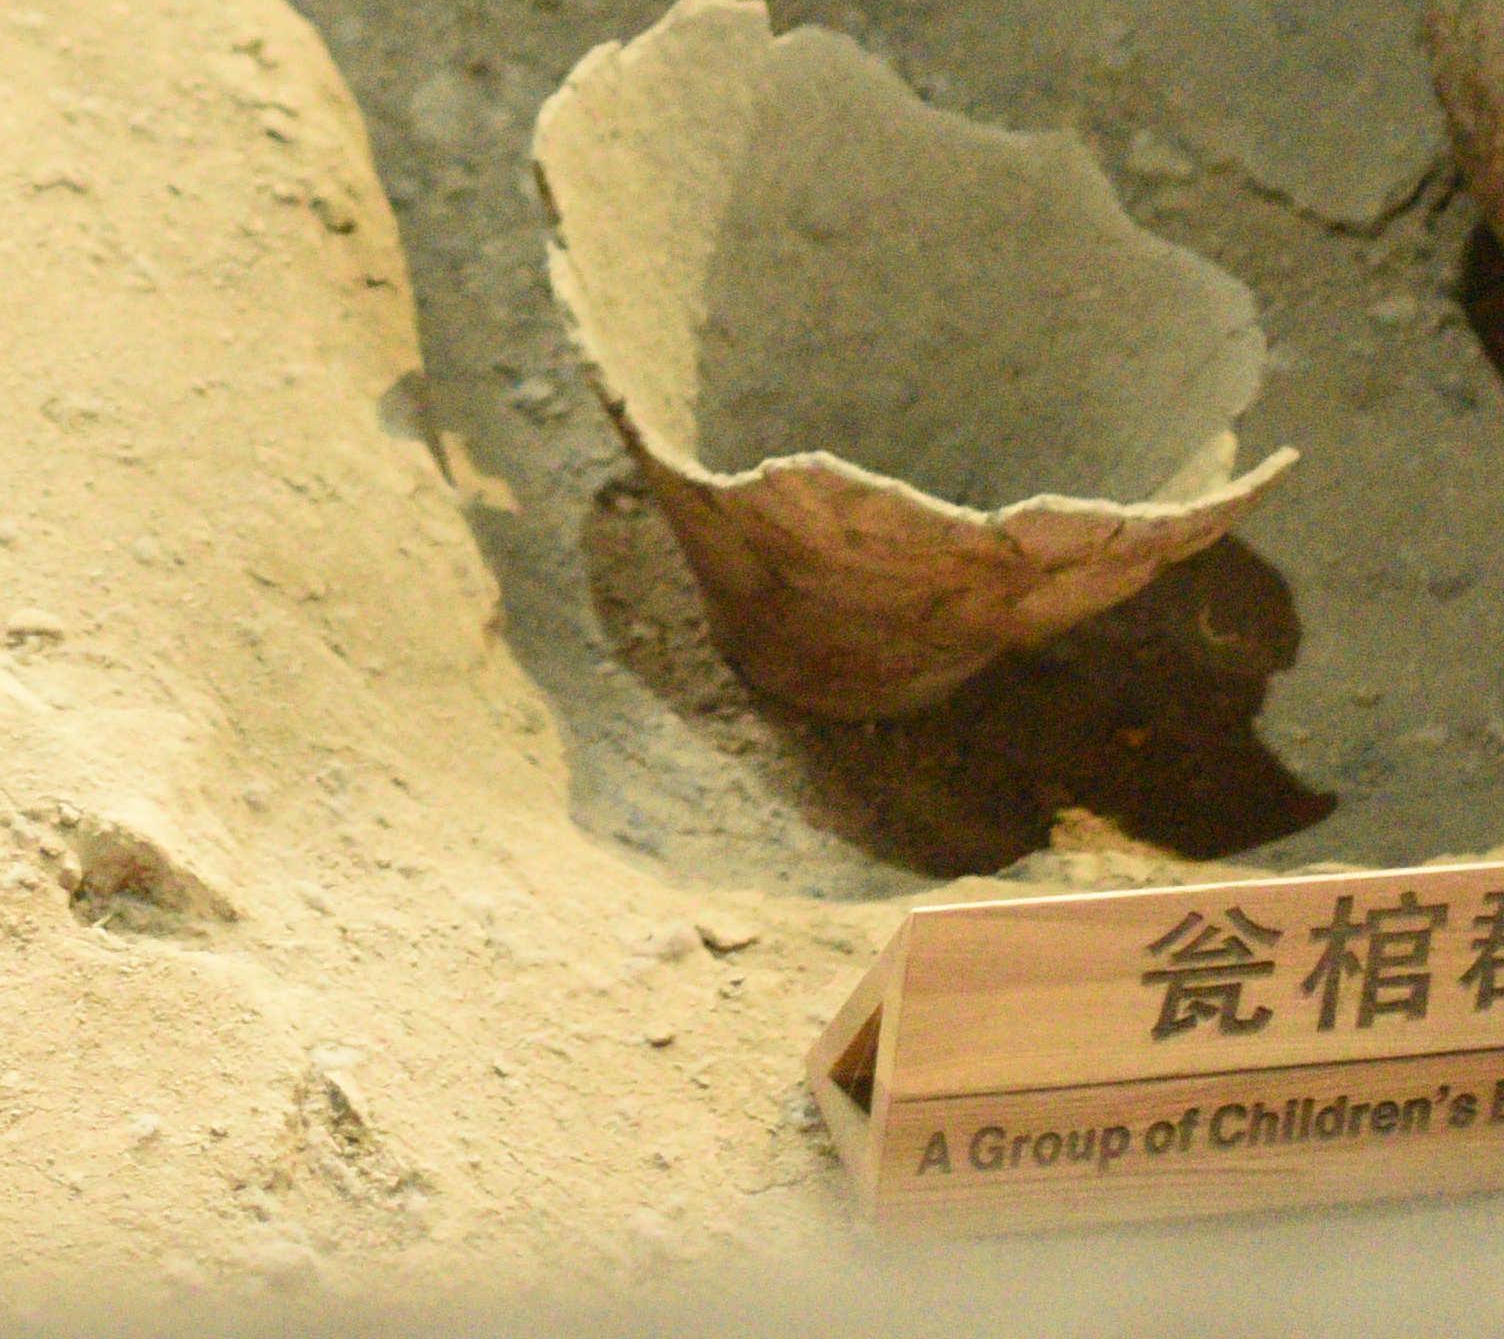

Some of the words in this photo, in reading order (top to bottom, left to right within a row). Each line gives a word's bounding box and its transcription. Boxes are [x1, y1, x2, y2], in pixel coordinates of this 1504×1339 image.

[919, 1131, 950, 1173] A
[970, 1124, 1131, 1170] Group
[1143, 1110, 1199, 1153] of
[1209, 1084, 1479, 1146] Children's
